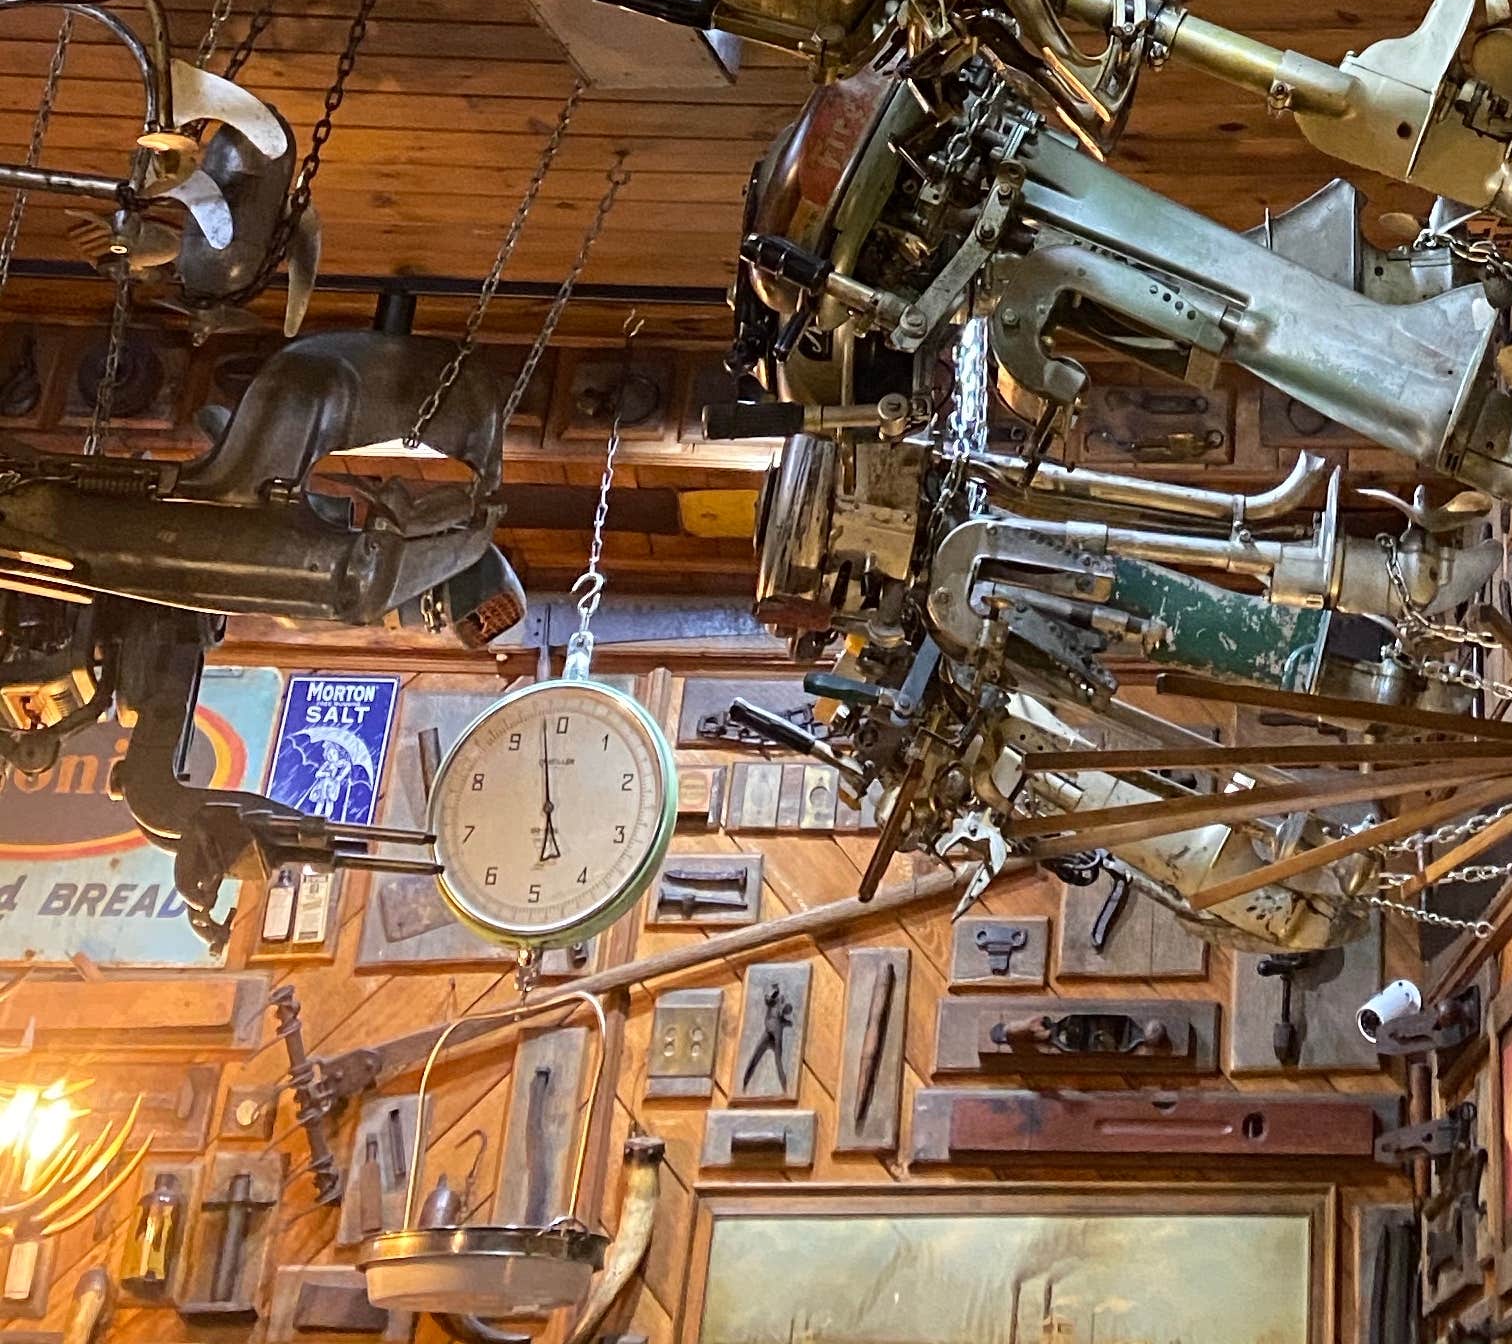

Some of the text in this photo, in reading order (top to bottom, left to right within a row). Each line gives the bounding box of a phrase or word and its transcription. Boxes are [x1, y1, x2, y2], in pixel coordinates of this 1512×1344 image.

[306, 681, 376, 703] MORTON
[305, 705, 371, 724] SALT
[556, 716, 569, 734] 0
[508, 733, 521, 751] 9
[601, 733, 609, 751] 1
[471, 773, 485, 791] 8
[621, 773, 634, 791] 2
[462, 825, 475, 845] 7
[613, 825, 625, 844] 3
[485, 866, 498, 886] 6
[576, 866, 588, 885] 4
[37, 882, 190, 918] BREAD
[527, 884, 541, 904] 5
